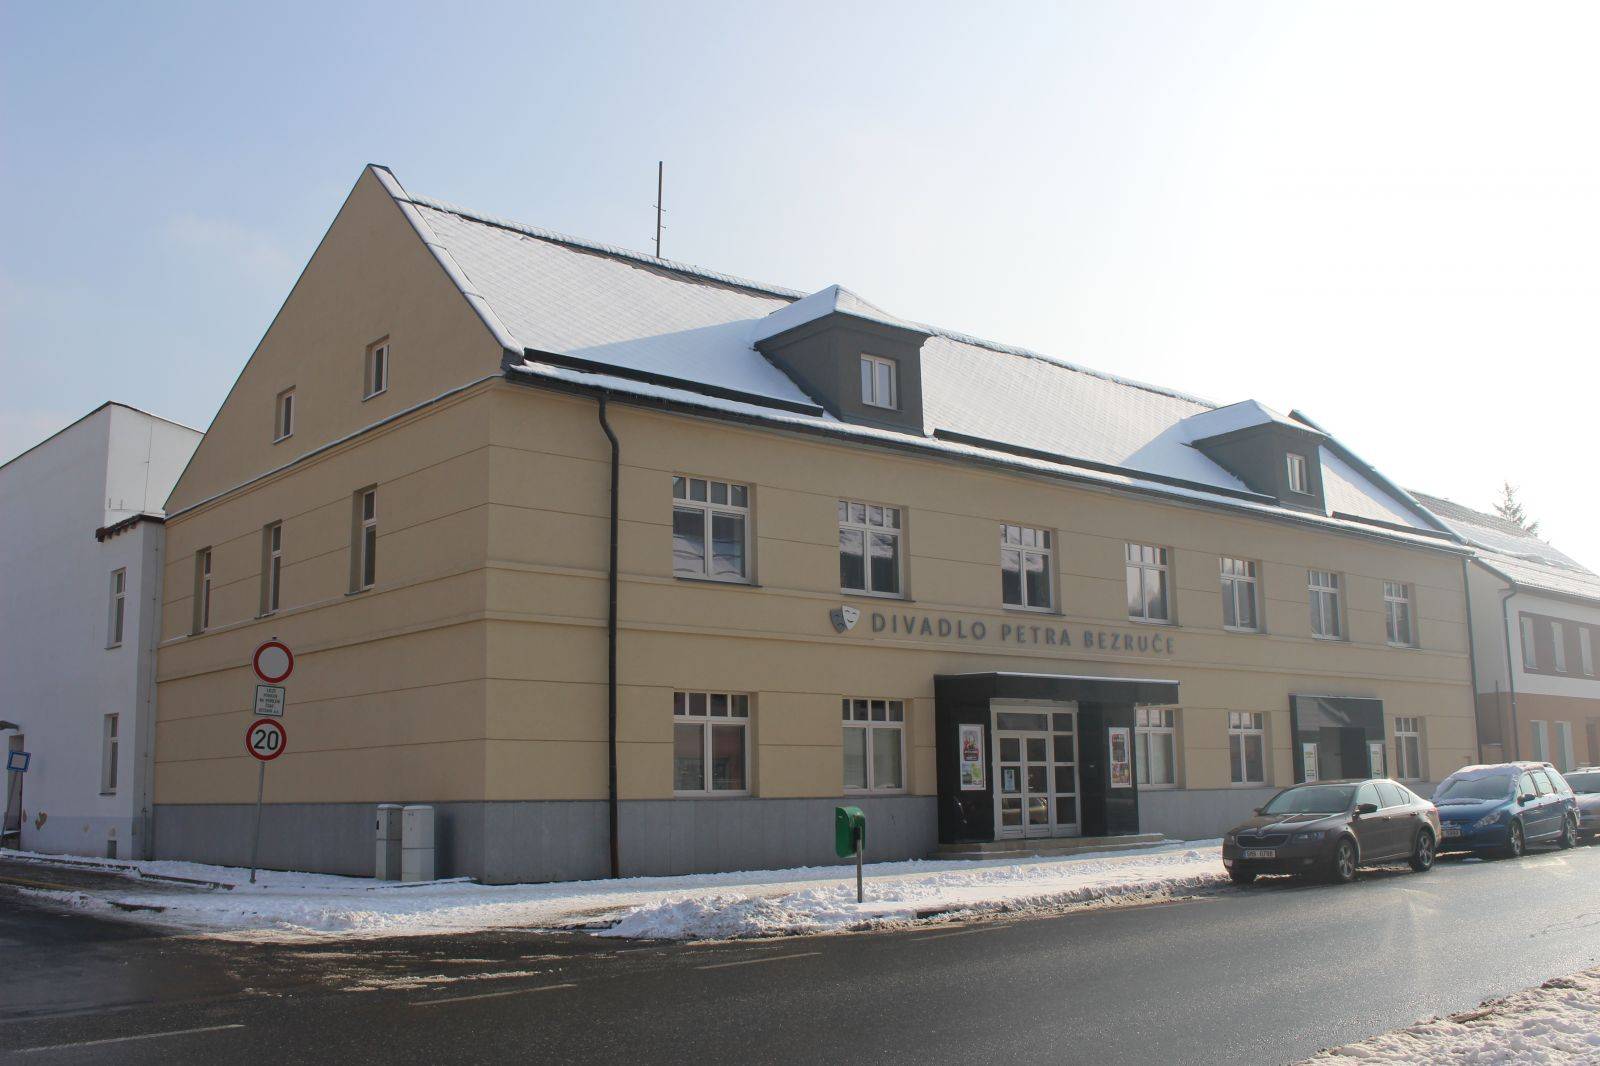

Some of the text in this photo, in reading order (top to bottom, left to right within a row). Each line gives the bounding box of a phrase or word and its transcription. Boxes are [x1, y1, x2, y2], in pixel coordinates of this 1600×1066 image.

[871, 612, 1175, 655] DIVADLO PETRA BEZRUČE
[253, 729, 279, 751] 20
